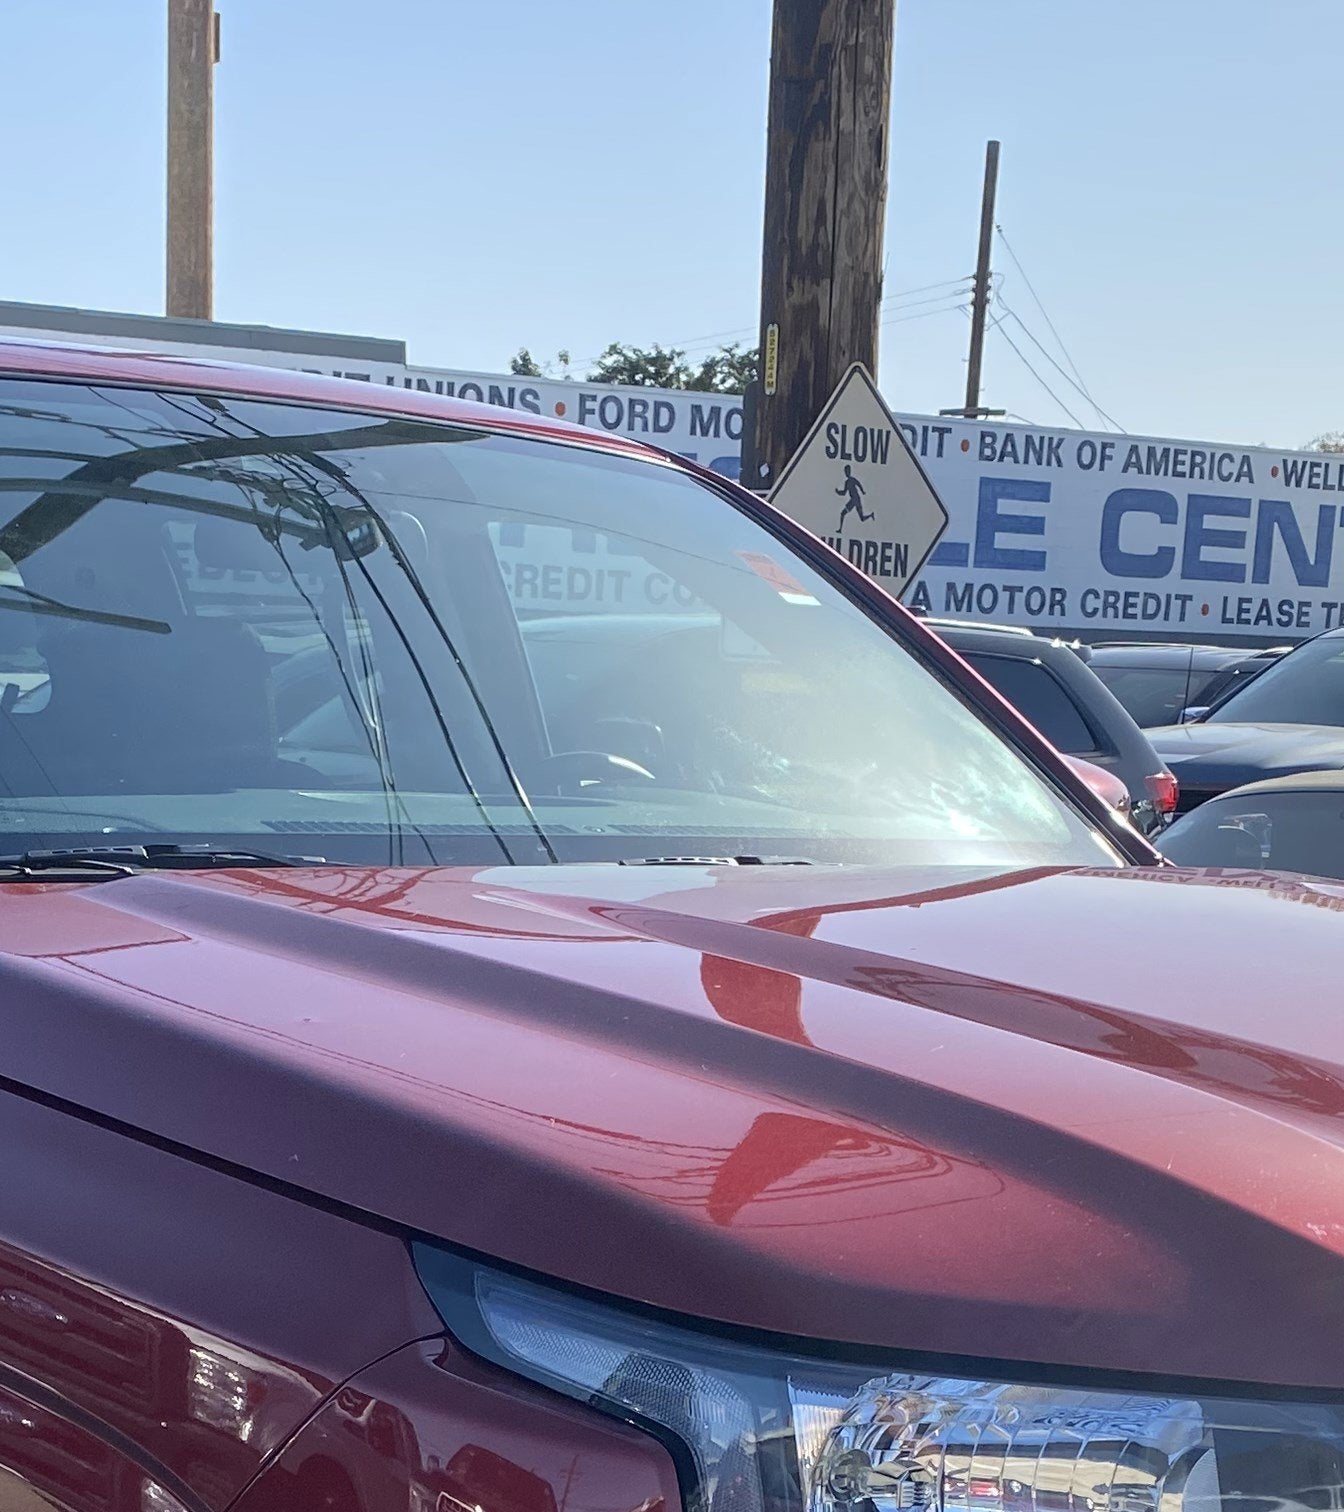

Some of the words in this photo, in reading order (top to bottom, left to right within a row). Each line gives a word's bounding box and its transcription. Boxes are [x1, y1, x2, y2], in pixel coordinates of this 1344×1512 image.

[576, 391, 676, 434] FORD
[824, 421, 892, 466] SLOW
[977, 430, 1066, 468] BANK
[1076, 438, 1115, 472] OF
[1121, 444, 1255, 484] AMERICA
[944, 581, 1067, 617] MOTOR
[1080, 587, 1194, 622] CREDIT
[1221, 595, 1312, 628] LEASE
